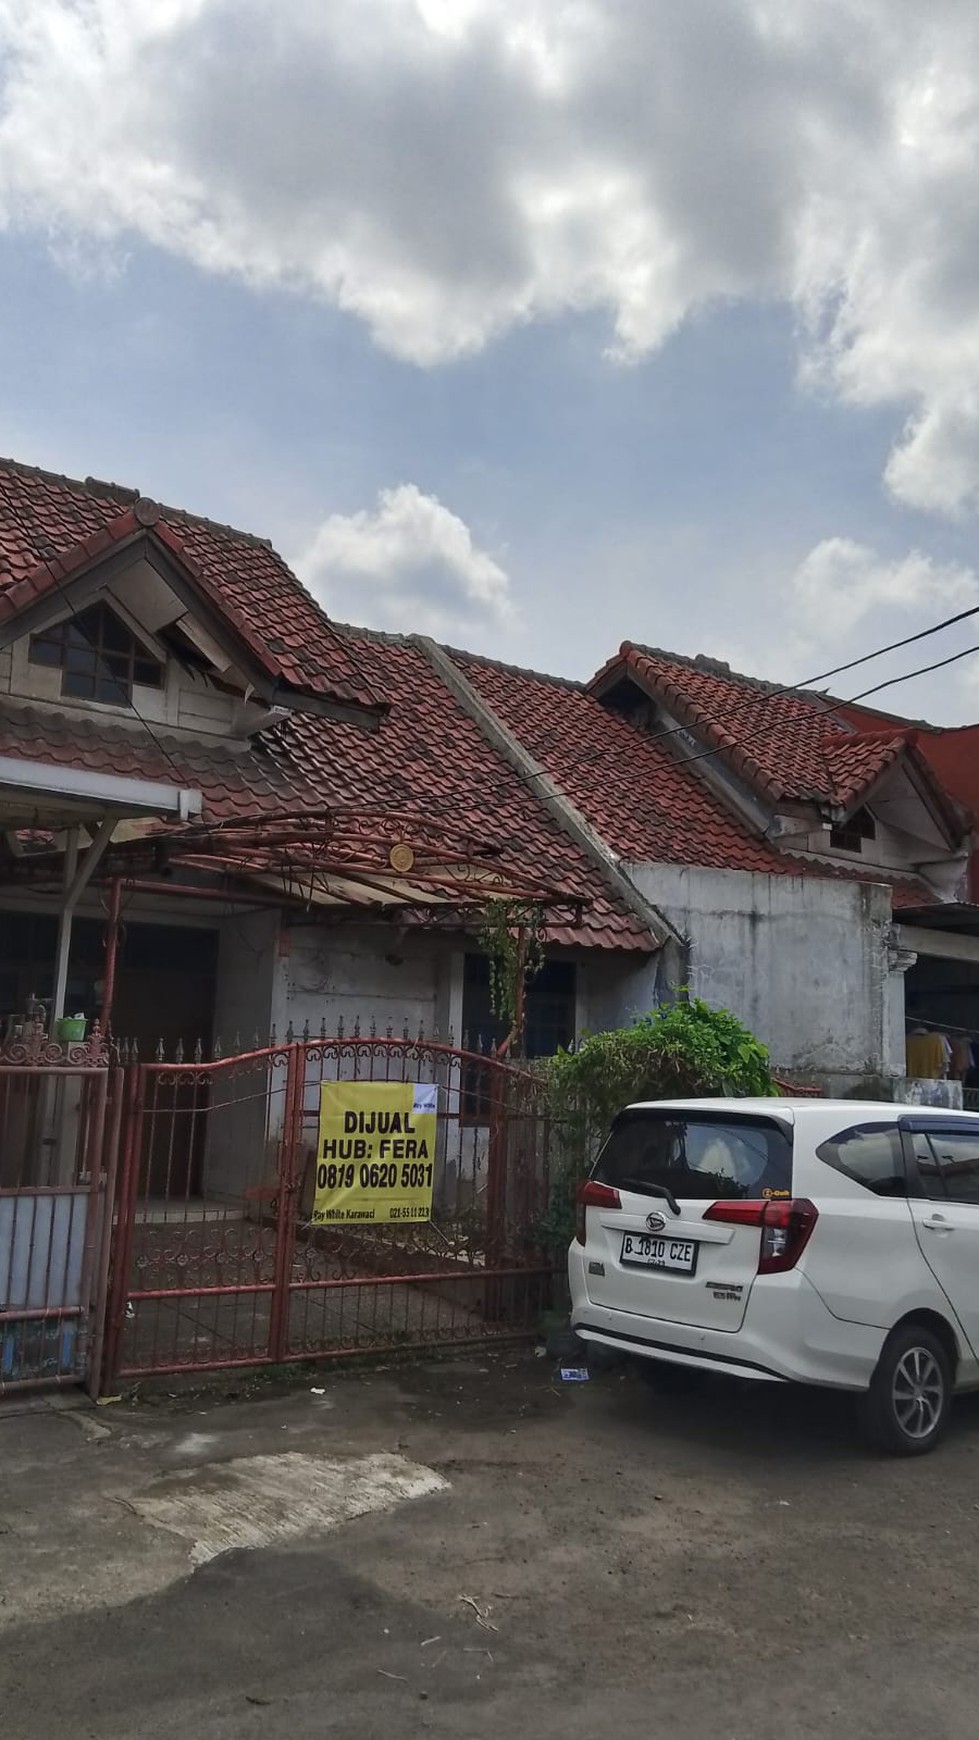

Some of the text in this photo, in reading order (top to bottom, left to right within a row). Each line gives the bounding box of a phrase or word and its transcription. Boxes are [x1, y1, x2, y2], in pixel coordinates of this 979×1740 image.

[345, 1111, 415, 1134] DIJUAL
[323, 1139, 428, 1159] HUB: FERA
[318, 1163, 432, 1189] 0819 0620 5031
[326, 1209, 344, 1219] White
[346, 1208, 375, 1219] Karawaci
[625, 1237, 692, 1262] B 1810 CZE
